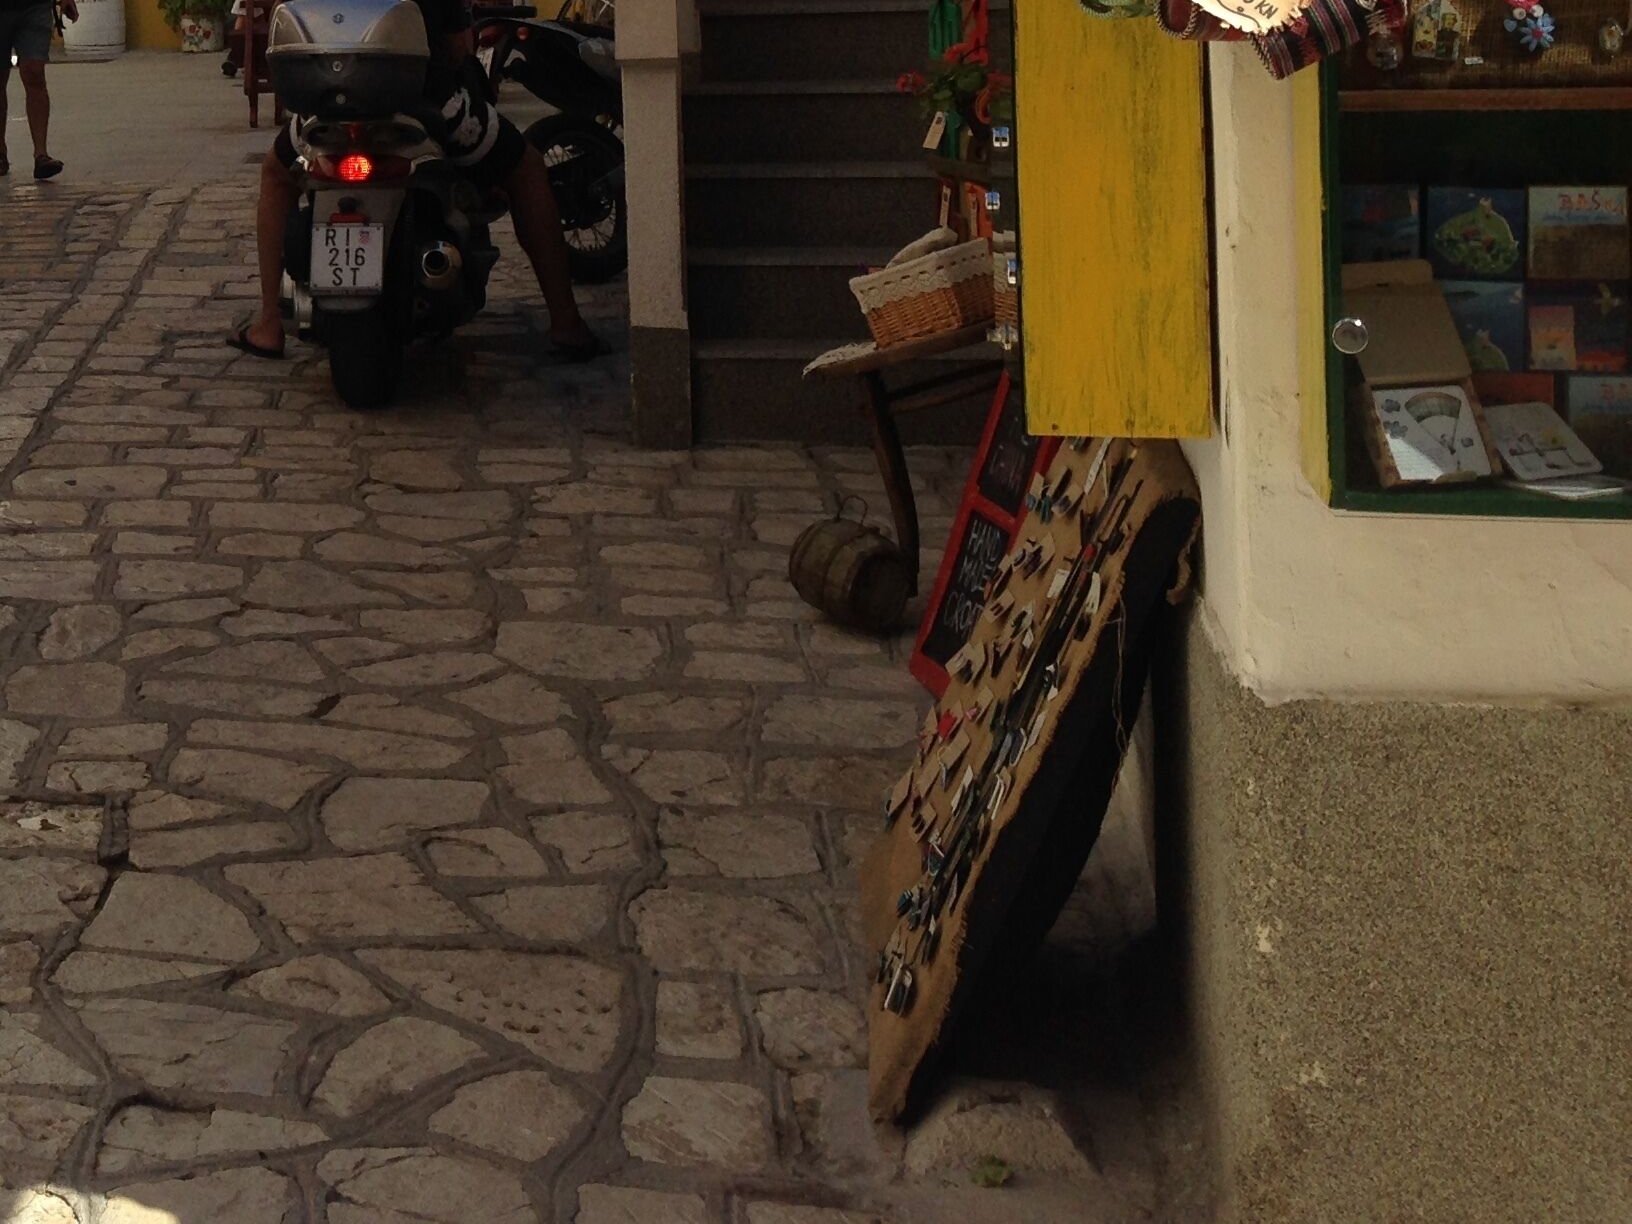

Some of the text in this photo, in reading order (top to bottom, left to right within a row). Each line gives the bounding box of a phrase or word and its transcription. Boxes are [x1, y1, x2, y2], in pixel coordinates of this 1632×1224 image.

[1254, 0, 1279, 20] KN
[325, 227, 351, 247] RI
[328, 247, 366, 267] 216
[331, 267, 361, 286] ST
